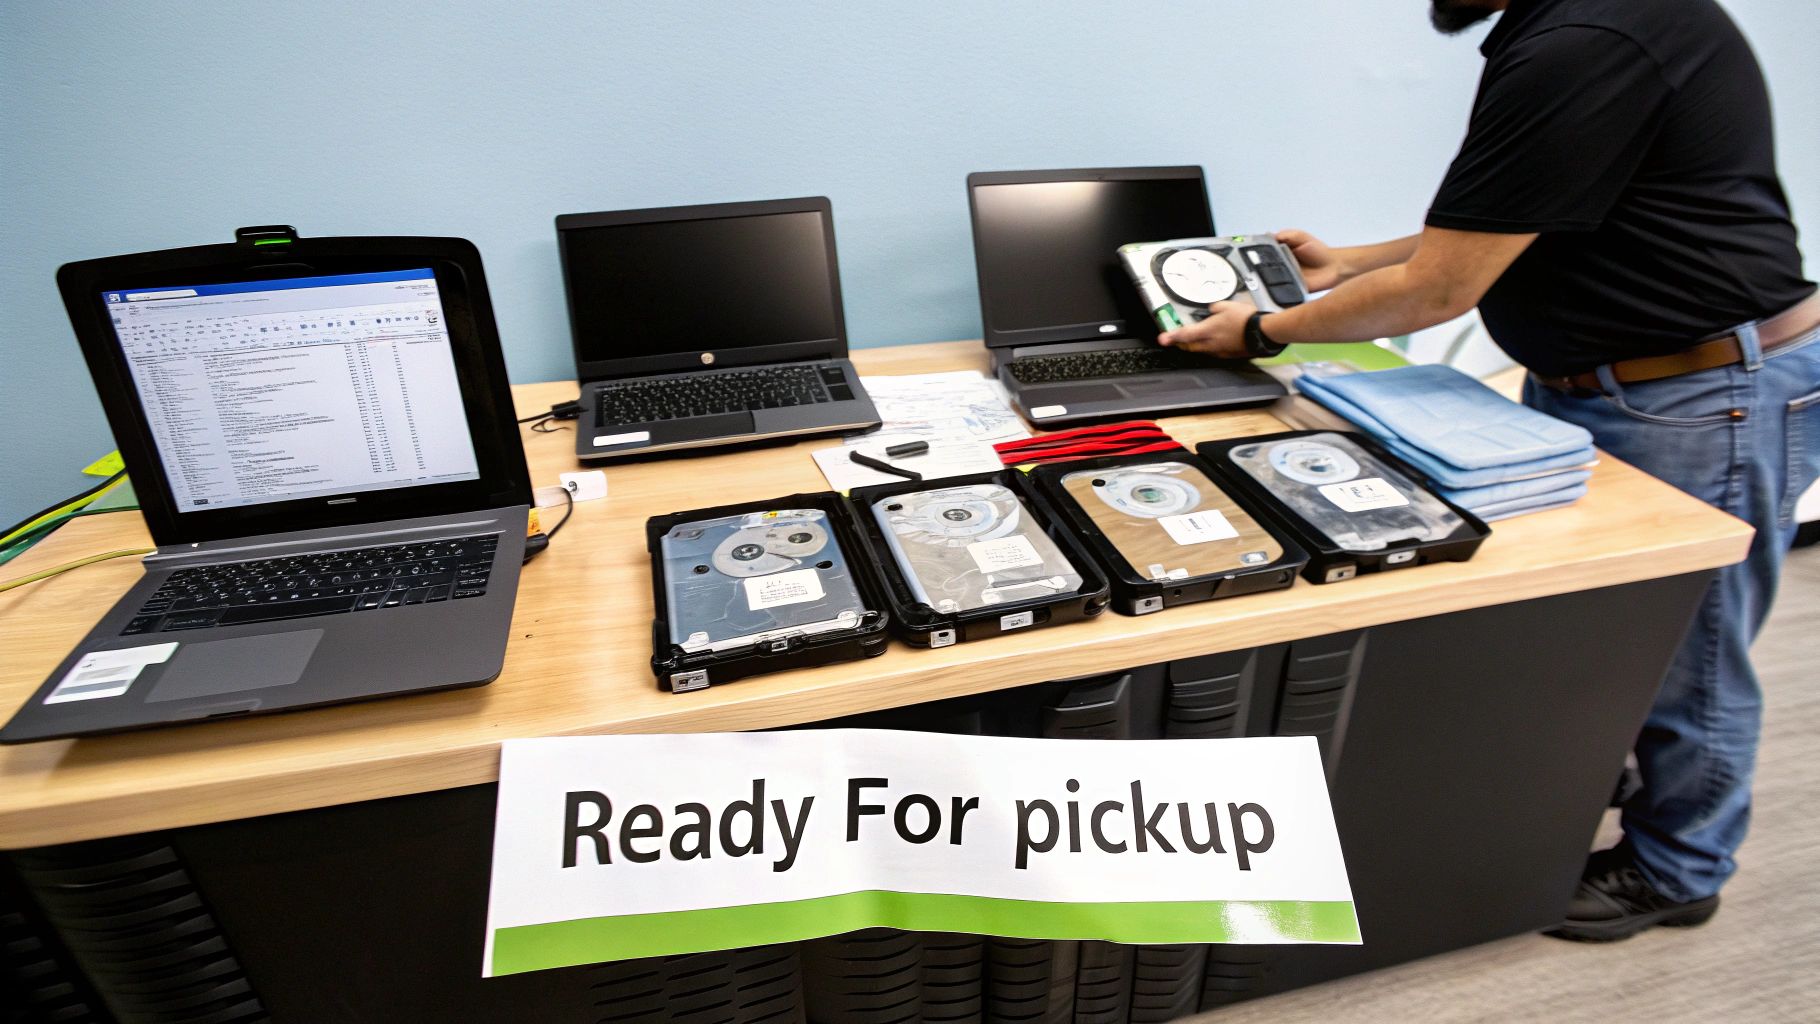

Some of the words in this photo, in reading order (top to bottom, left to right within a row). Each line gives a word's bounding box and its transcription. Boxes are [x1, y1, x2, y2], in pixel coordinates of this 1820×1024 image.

[563, 779, 815, 872] Ready
[846, 778, 979, 845] For
[1015, 778, 1275, 871] pickup
